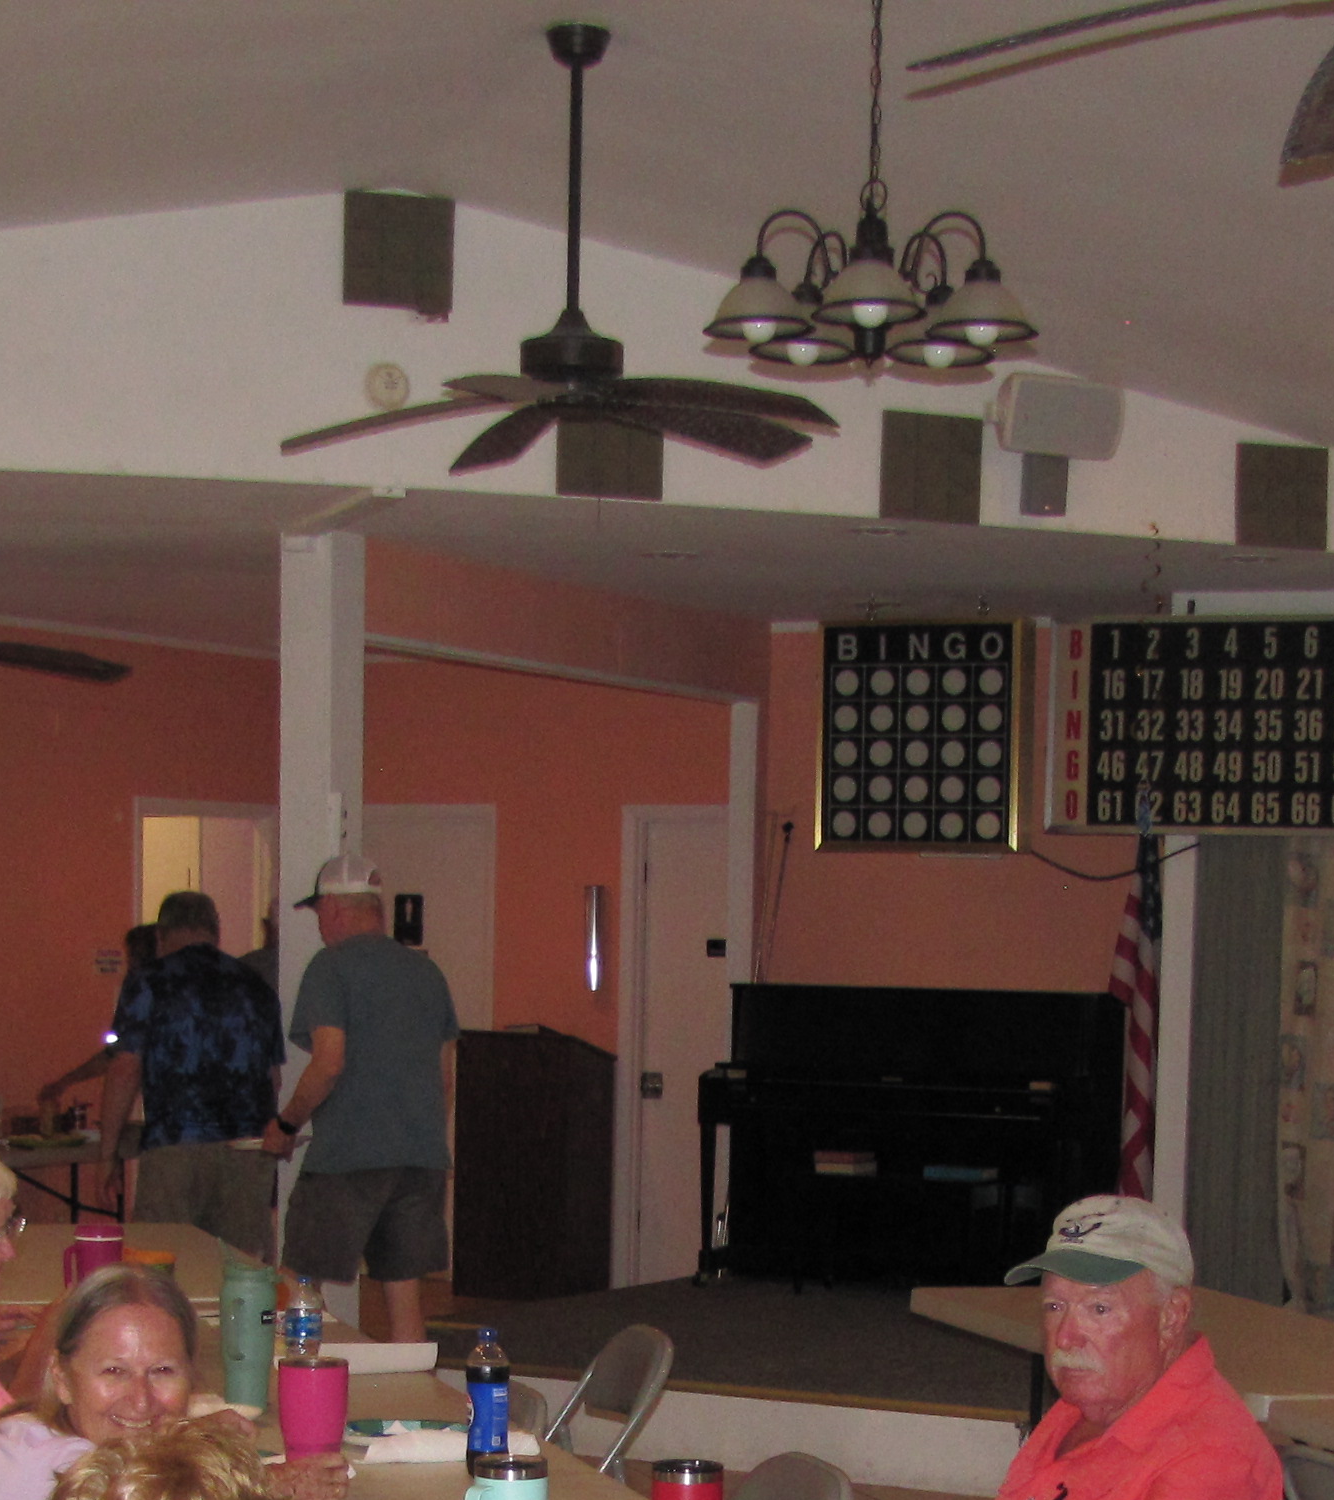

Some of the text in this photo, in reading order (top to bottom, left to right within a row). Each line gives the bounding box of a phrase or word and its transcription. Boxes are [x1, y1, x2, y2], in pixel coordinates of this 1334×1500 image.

[1112, 629, 1120, 659] 1
[1146, 628, 1160, 660] 2
[1186, 627, 1200, 659] 3
[1224, 628, 1238, 658] 4
[1264, 626, 1277, 659] 5
[1304, 626, 1318, 658] 6
[1103, 669, 1125, 700] 16
[1142, 669, 1164, 699] 17
[1181, 669, 1203, 700] 18
[1220, 668, 1242, 700] 19
[1255, 668, 1284, 699] 20
[1297, 668, 1323, 700] 21
[1100, 709, 1124, 740] 31
[1136, 709, 1164, 741] 32
[1176, 709, 1204, 741] 33
[1214, 709, 1242, 741] 34
[1254, 709, 1282, 741] 35
[1294, 709, 1323, 741] 36
[1097, 750, 1125, 781] 46
[1136, 750, 1164, 783] 47
[1175, 750, 1203, 782] 48
[1214, 751, 1242, 782] 49
[1253, 751, 1281, 782] 50
[1295, 751, 1320, 783] 51
[1097, 791, 1123, 822] 61
[1136, 792, 1163, 823] 2
[1174, 792, 1201, 823] 63
[1212, 793, 1240, 824] 64
[1251, 793, 1279, 824] 65
[1292, 794, 1320, 825] 66
